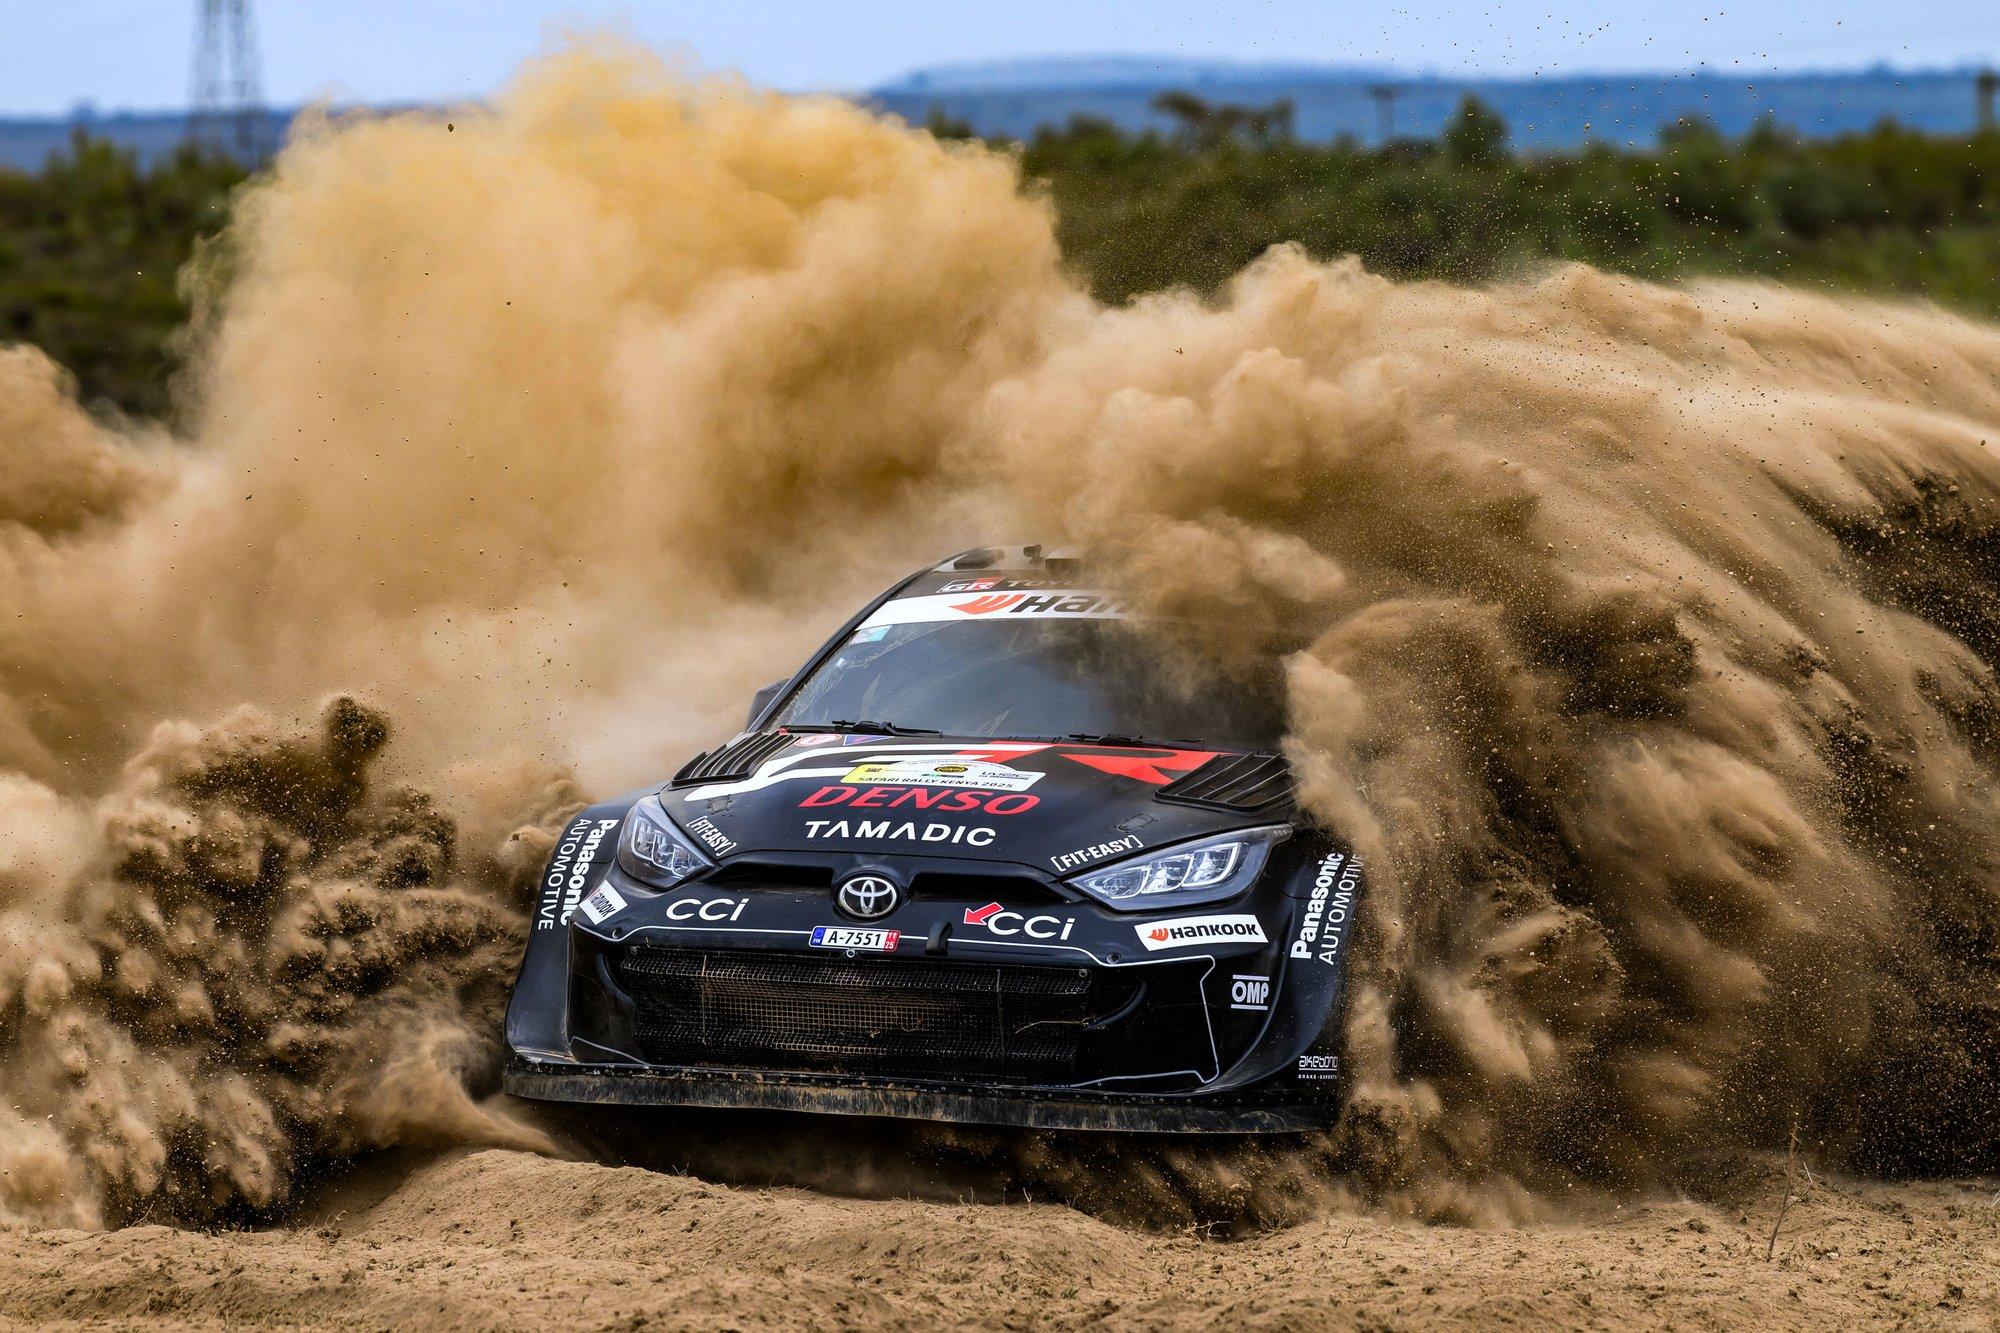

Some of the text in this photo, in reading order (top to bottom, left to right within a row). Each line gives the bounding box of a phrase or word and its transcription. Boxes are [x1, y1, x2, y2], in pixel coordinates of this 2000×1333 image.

[798, 786, 1041, 815] DENSO
[804, 820, 997, 846] TAMADIC
[538, 818, 593, 930] AUTOMOTIVE
[560, 819, 620, 926] Panasonic
[1290, 853, 1344, 960] Panasonic
[827, 930, 882, 946] A-7551
[884, 941, 895, 949] 25
[1231, 980, 1270, 1004] OMP
